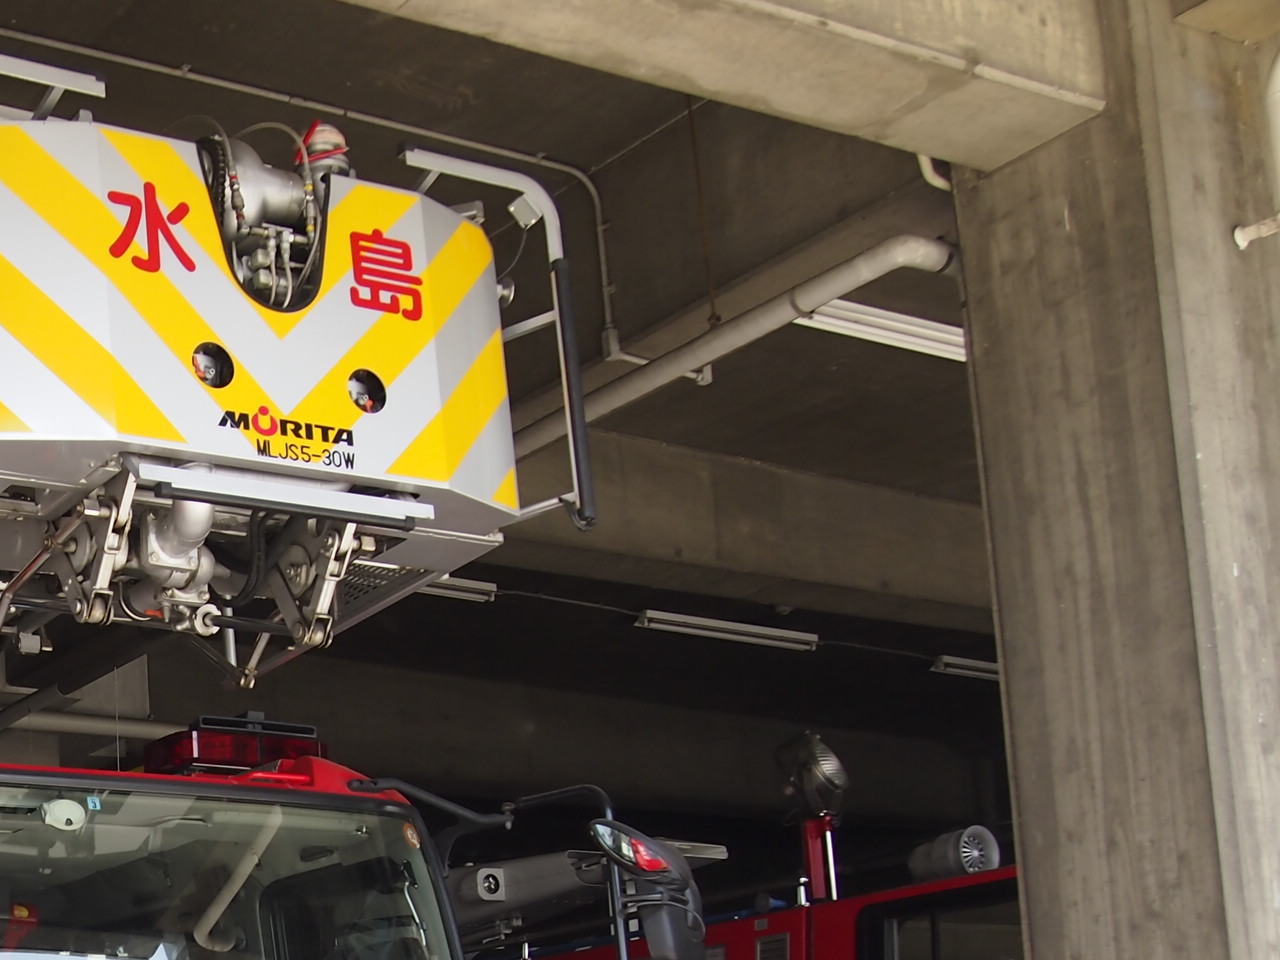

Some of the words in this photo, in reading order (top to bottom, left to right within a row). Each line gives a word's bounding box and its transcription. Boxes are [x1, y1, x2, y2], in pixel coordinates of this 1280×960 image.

[107, 181, 196, 273] 水
[349, 228, 423, 321] 島
[218, 405, 354, 447] MORITA
[256, 438, 355, 470] MLJS5-30W
